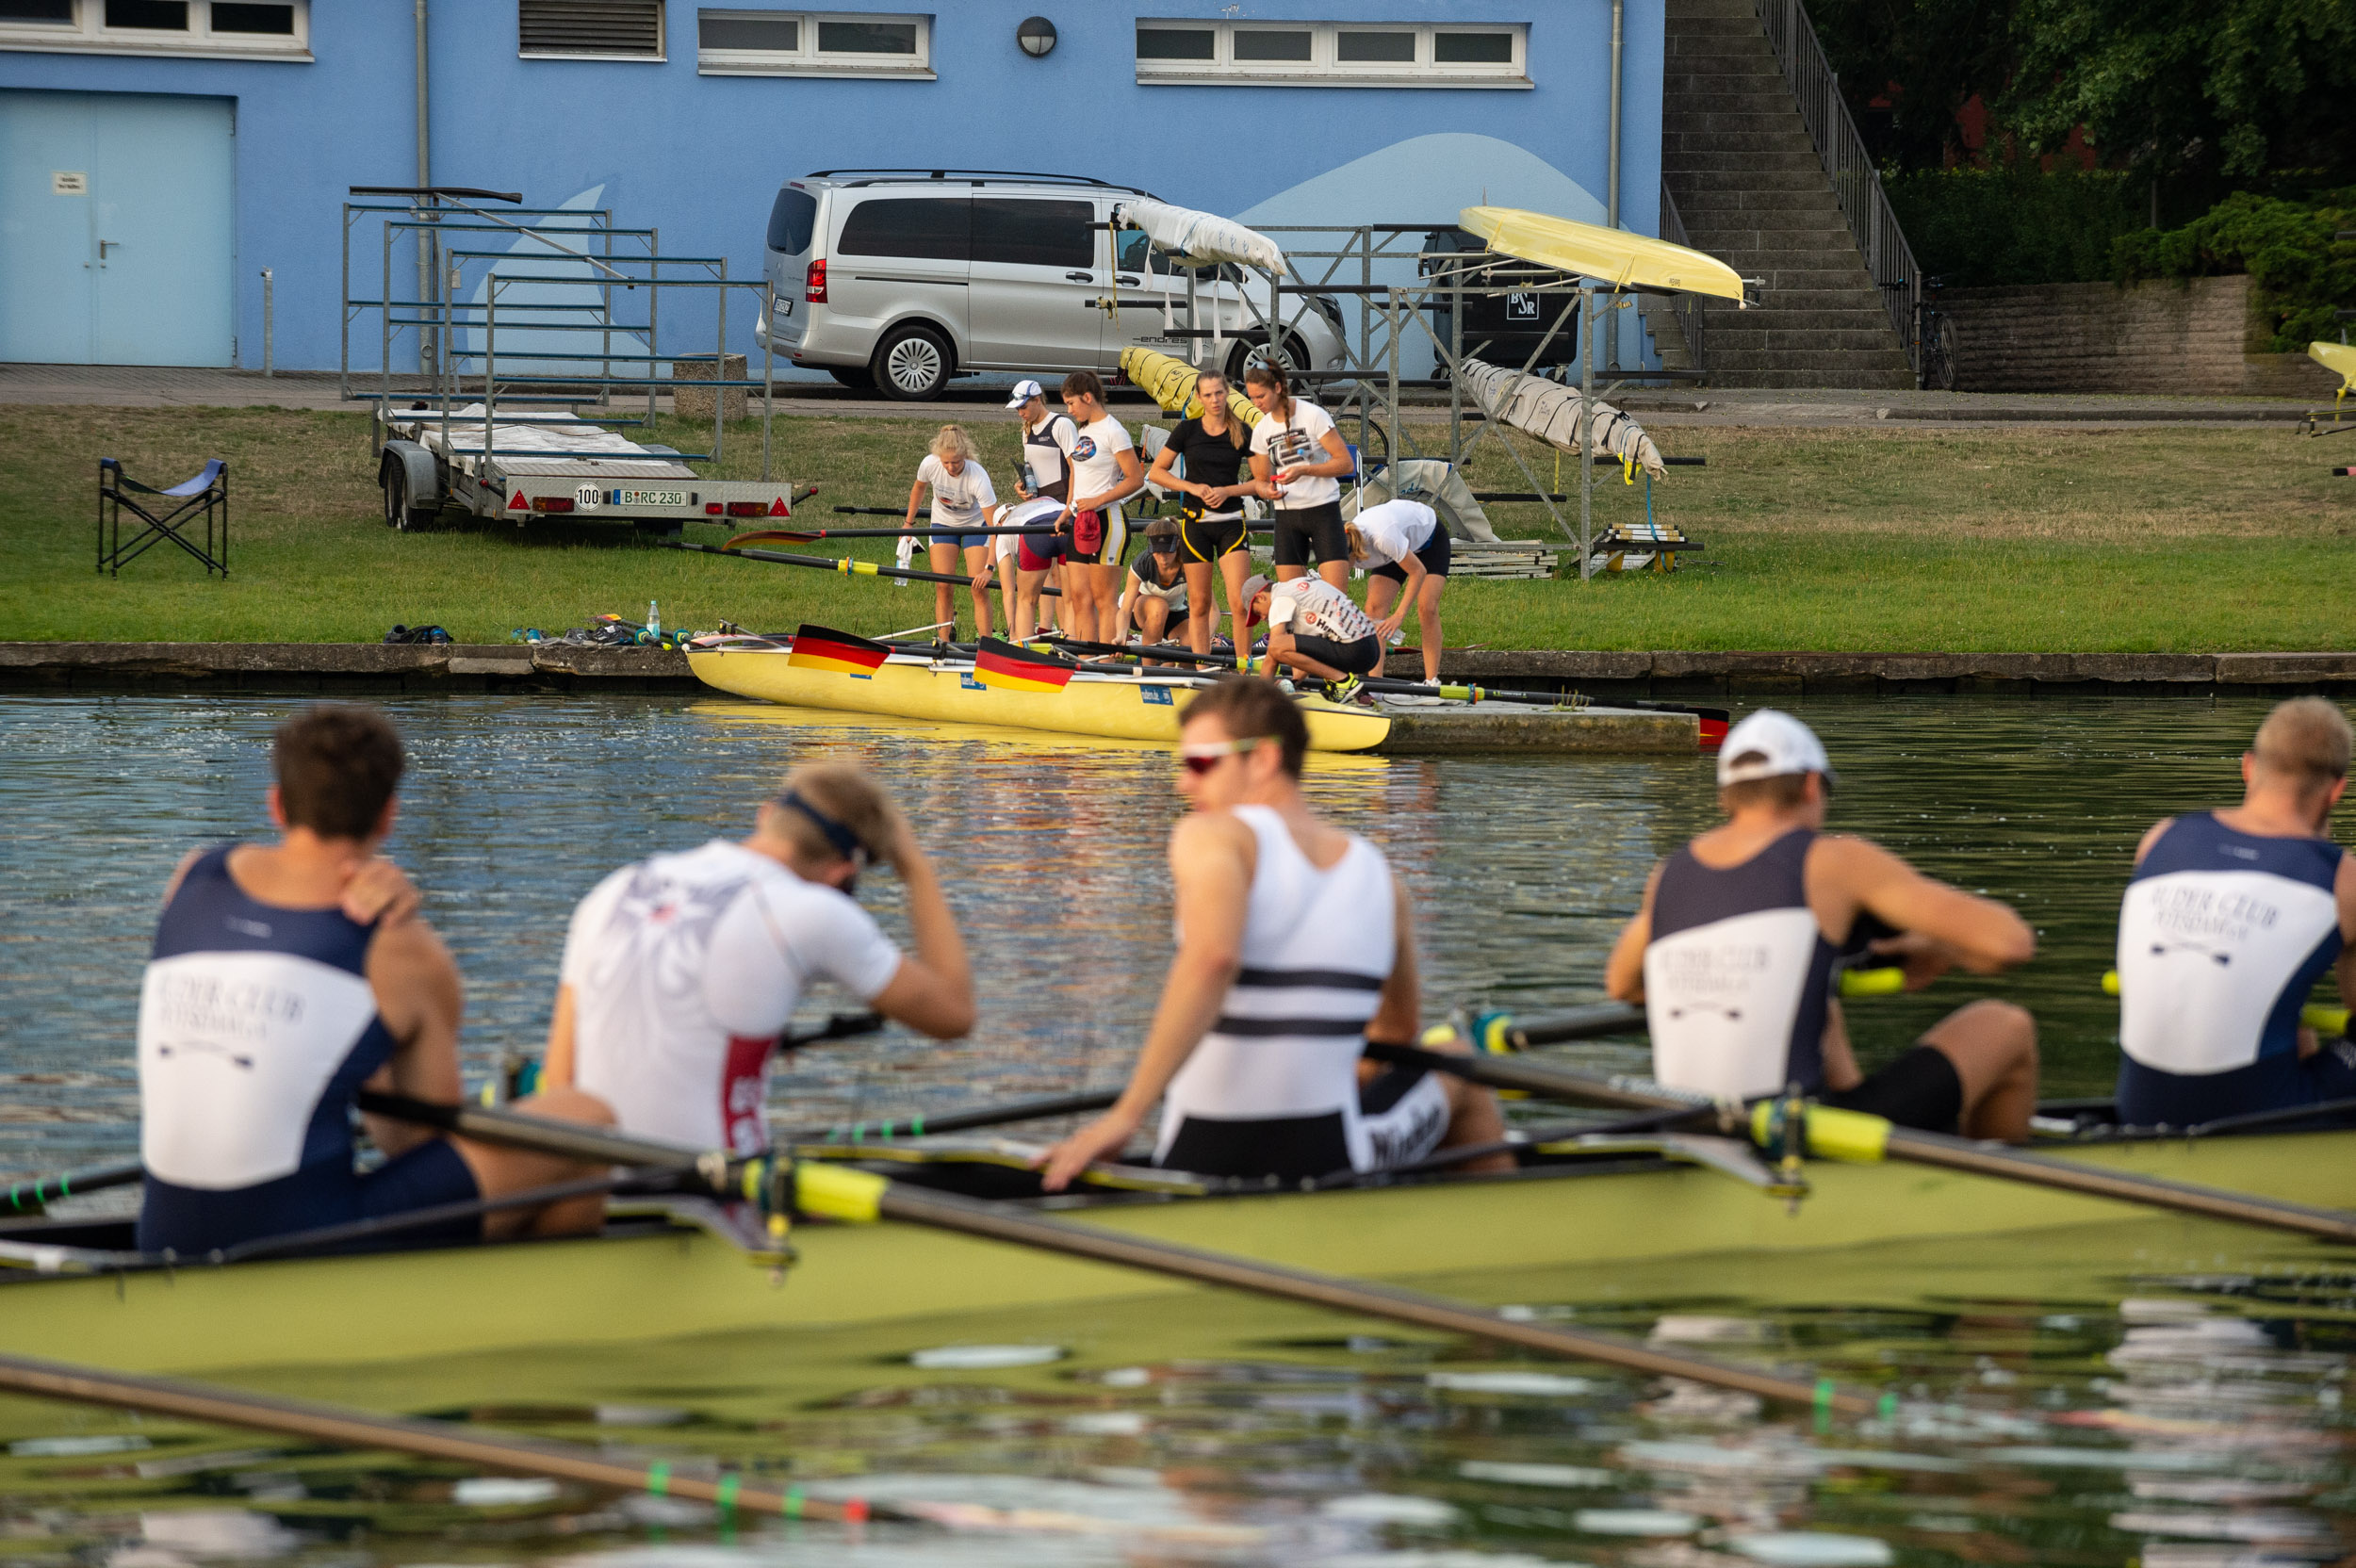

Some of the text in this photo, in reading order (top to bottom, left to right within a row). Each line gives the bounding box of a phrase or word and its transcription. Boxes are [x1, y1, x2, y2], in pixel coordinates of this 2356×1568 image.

[578, 489, 599, 504] 100
[625, 491, 681, 505] B RC 230
